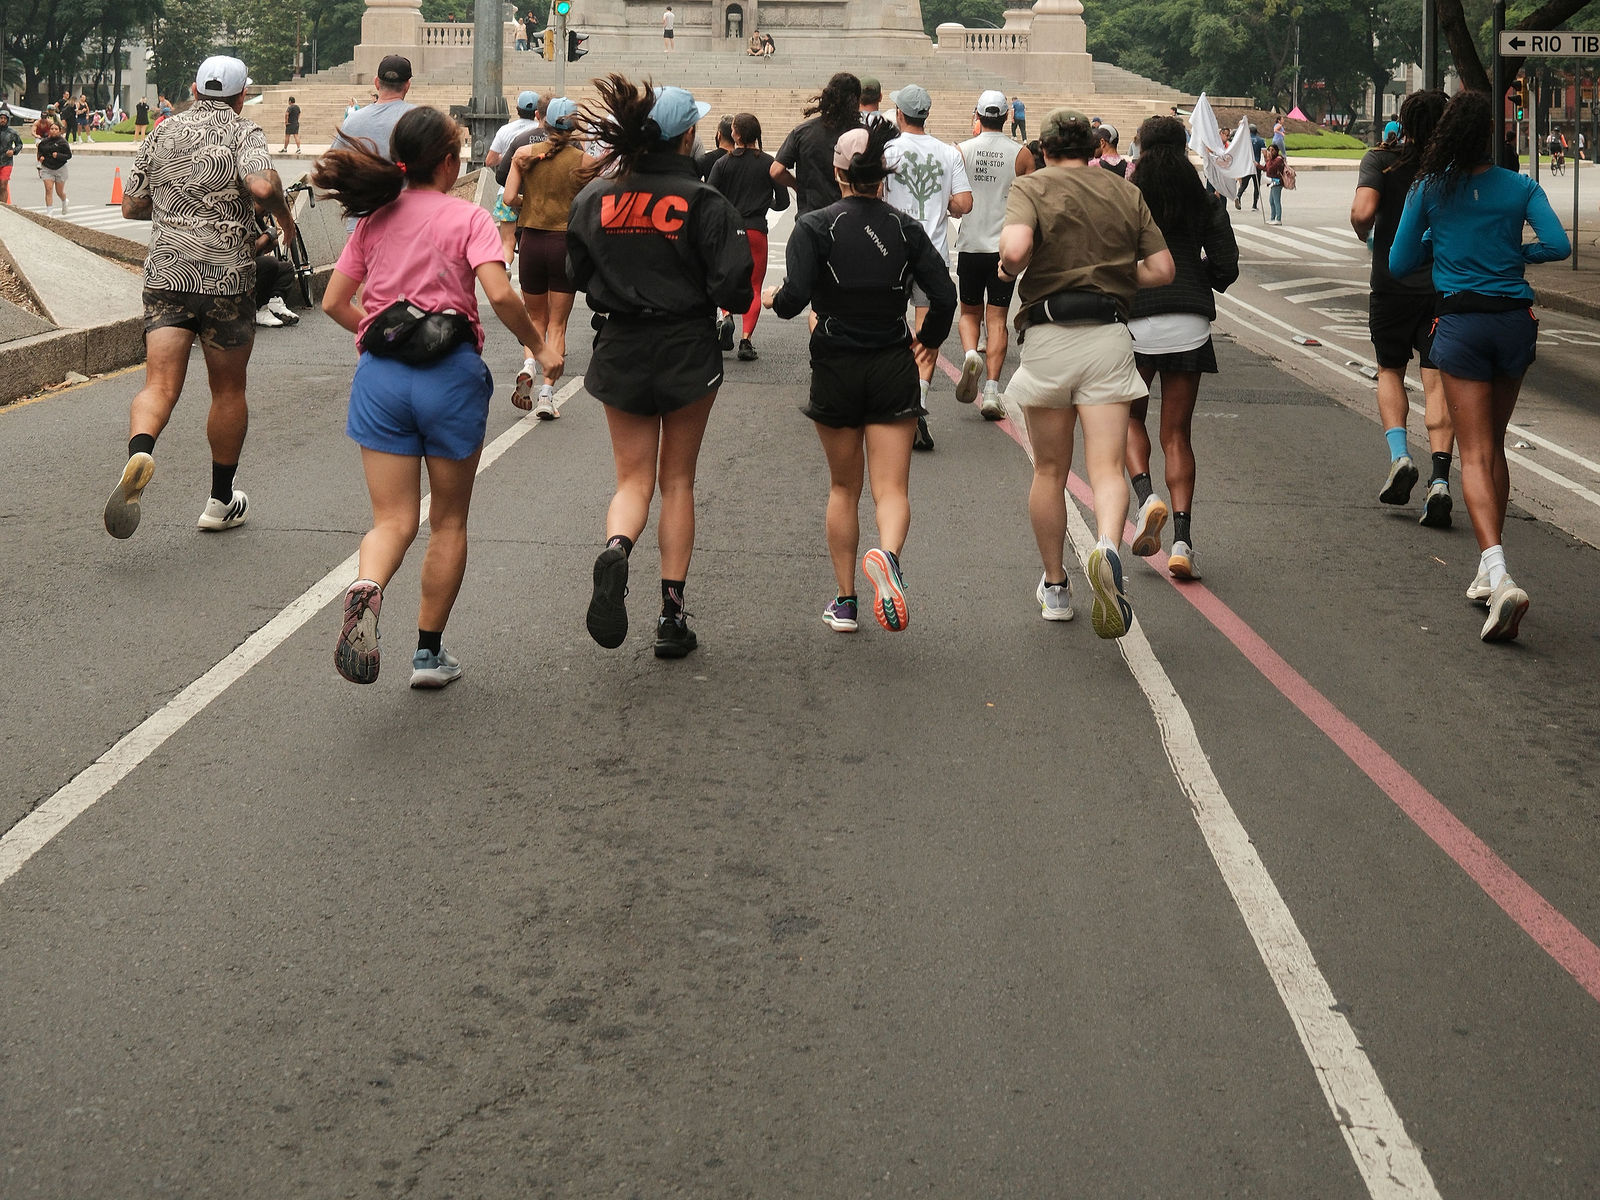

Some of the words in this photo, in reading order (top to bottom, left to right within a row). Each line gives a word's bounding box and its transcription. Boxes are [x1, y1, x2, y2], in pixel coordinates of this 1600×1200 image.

[1532, 36, 1562, 52] RIO
[1571, 36, 1599, 52] TIB
[976, 159, 1004, 167] NON-STOP
[974, 175, 997, 183] SOCIETY
[601, 192, 689, 232] VLC
[864, 225, 889, 257] NATHAN
